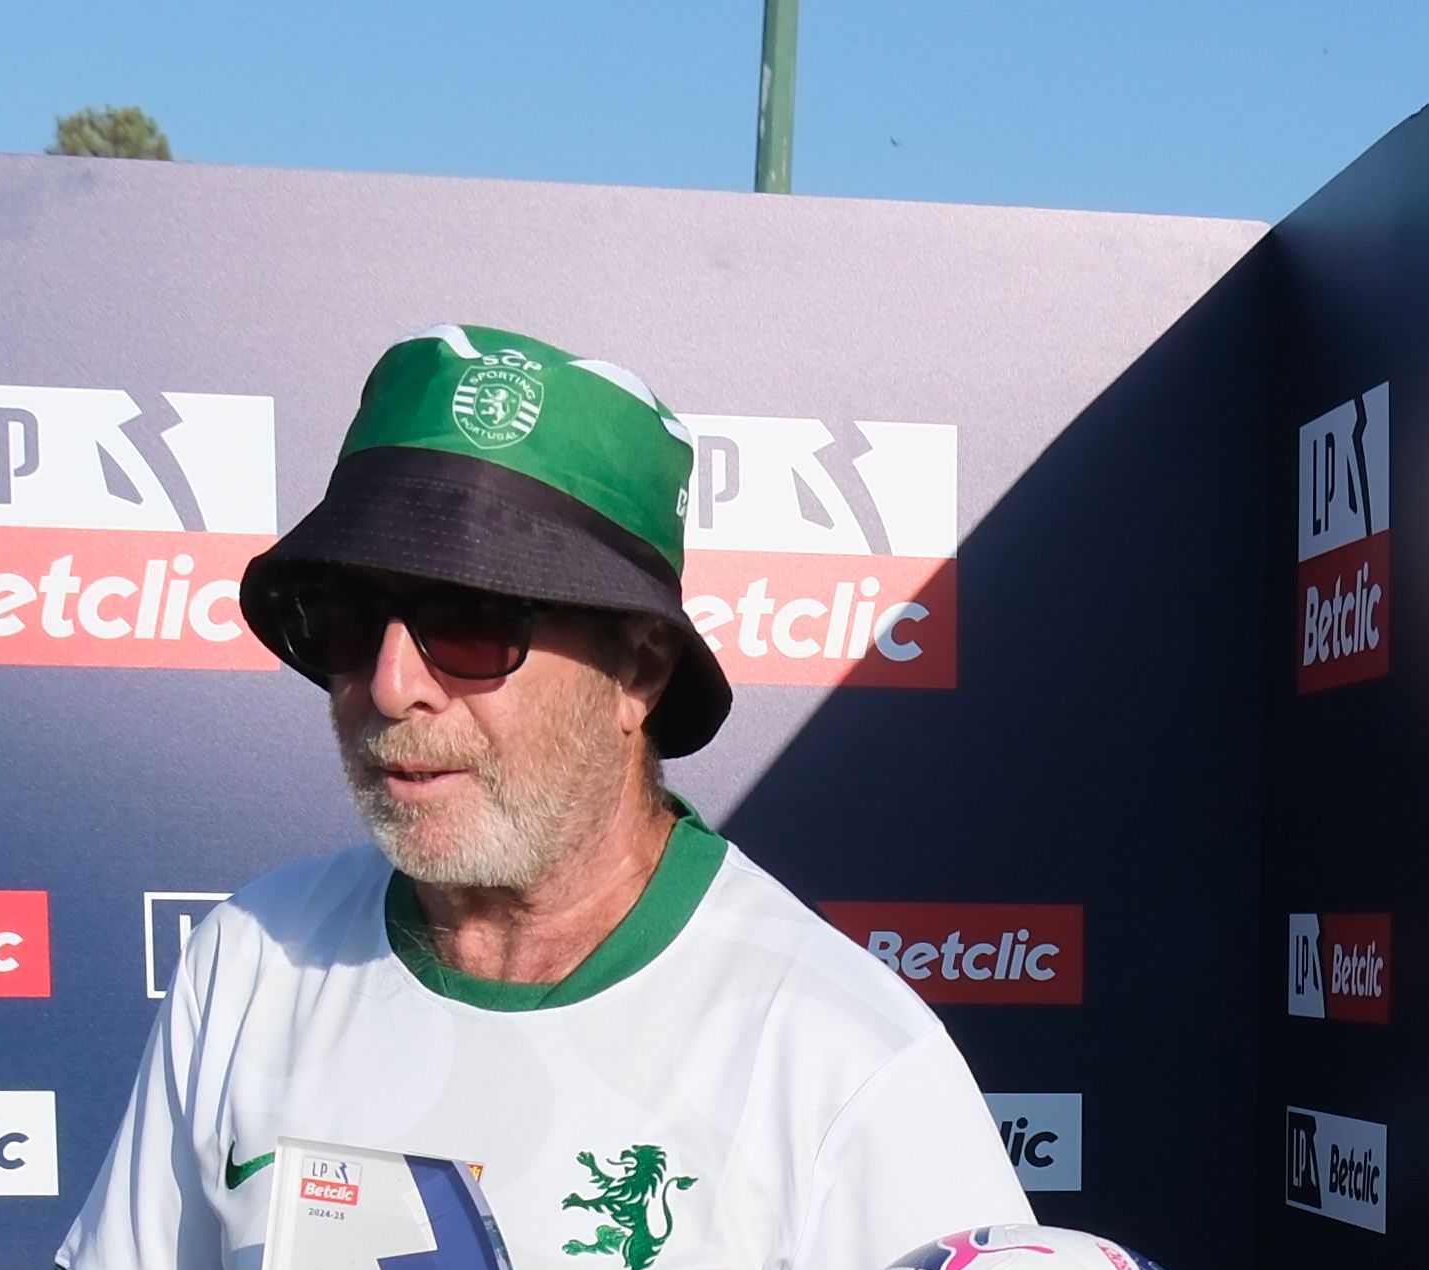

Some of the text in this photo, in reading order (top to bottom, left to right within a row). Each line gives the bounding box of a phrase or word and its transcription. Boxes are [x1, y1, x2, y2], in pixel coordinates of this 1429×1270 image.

[469, 370, 536, 401] SPORTING
[482, 353, 542, 372] SCP
[459, 416, 520, 441] PORTUGAL
[697, 435, 740, 529] P
[1312, 432, 1335, 537] LP
[682, 576, 930, 662] etclic
[1303, 561, 1382, 666] Betclic
[1295, 935, 1384, 998] LP Betclic
[304, 1181, 354, 1202] Betclic
[312, 1161, 328, 1177] LP
[1292, 1128, 1381, 1206] LP Betclic
